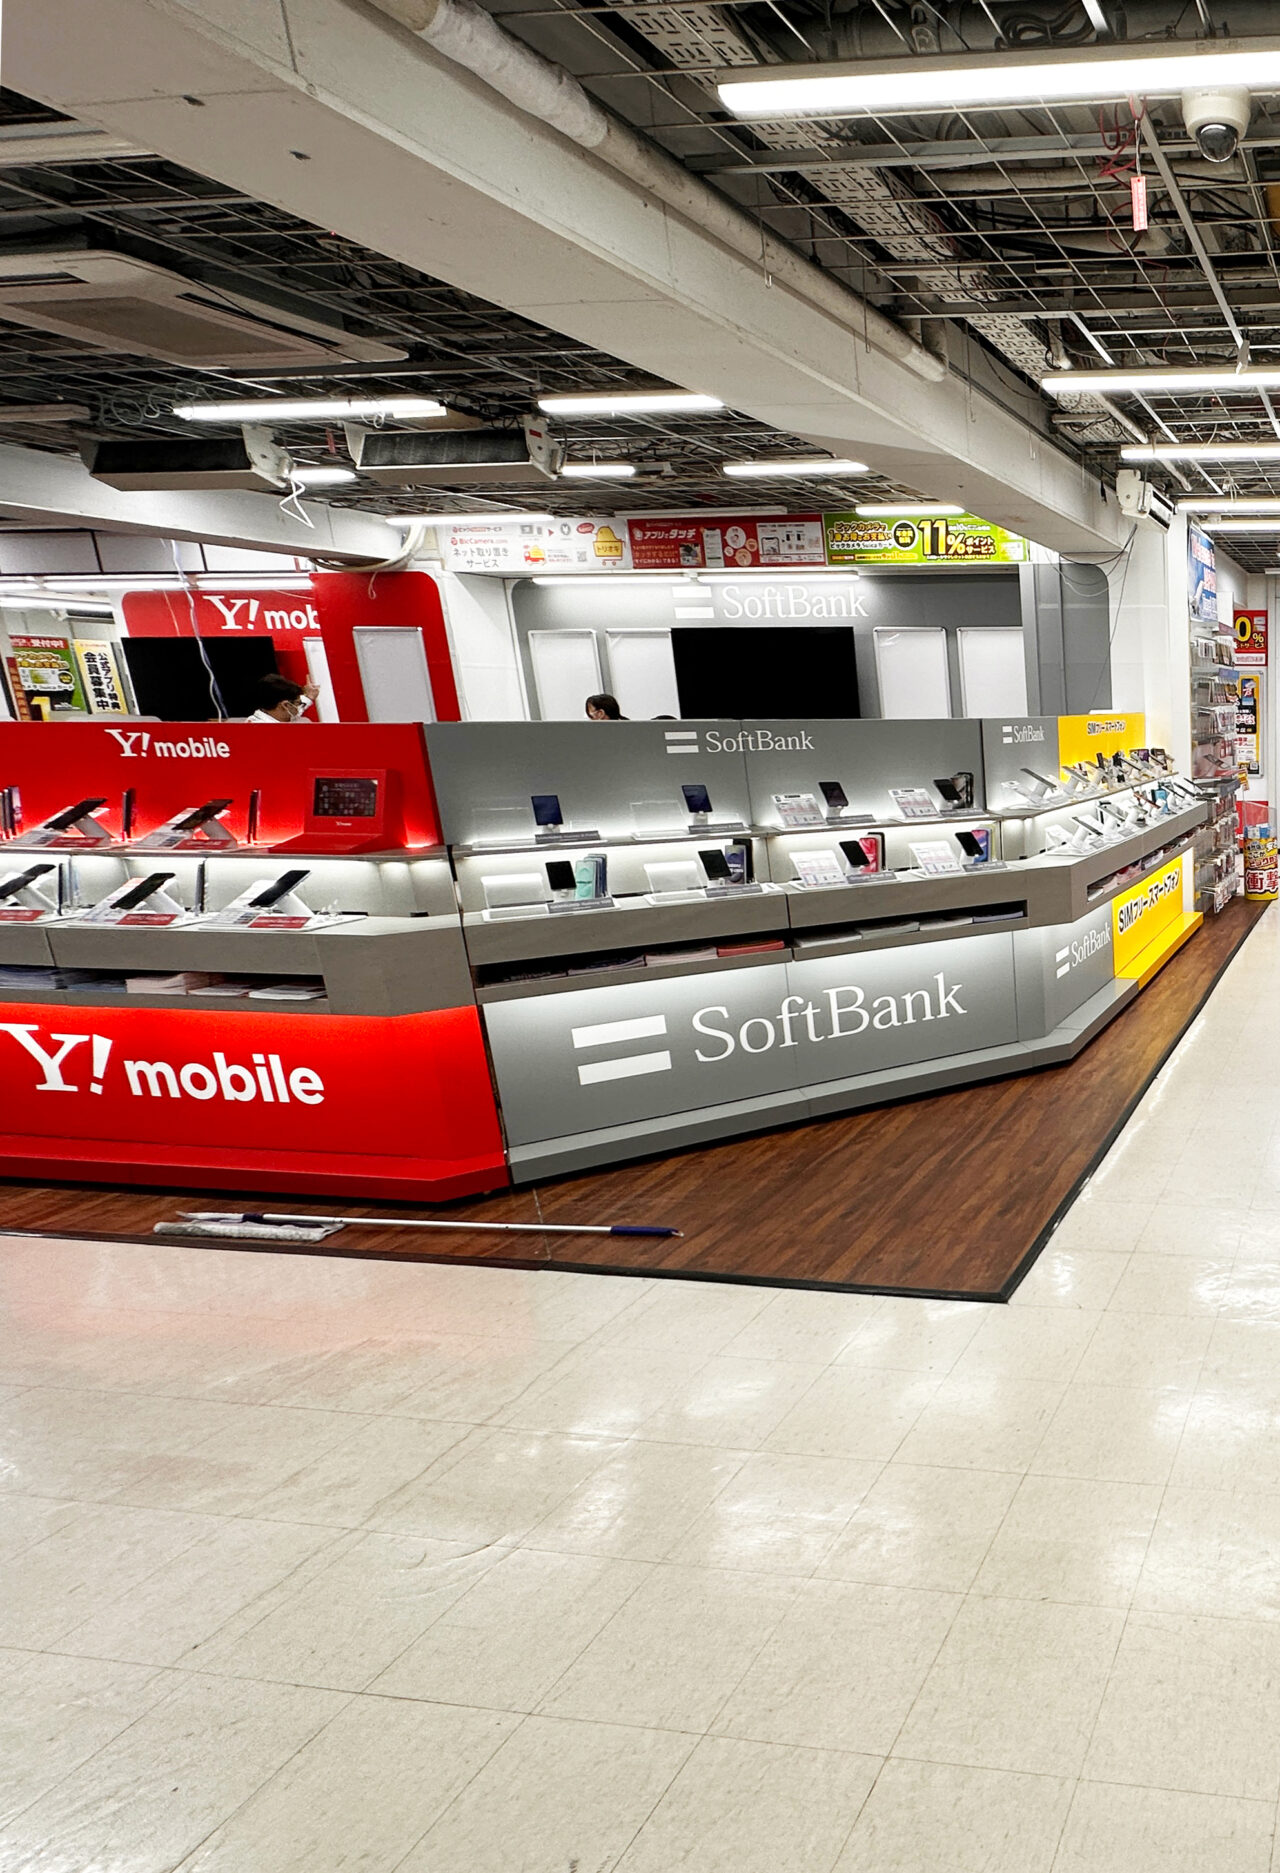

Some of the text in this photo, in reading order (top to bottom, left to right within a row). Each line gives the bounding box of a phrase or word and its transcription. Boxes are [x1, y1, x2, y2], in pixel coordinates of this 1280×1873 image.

[453, 547, 510, 558] ネット取り置き
[917, 519, 967, 555] 11%
[965, 536, 995, 546] ポイント
[965, 545, 997, 554] サービス
[466, 559, 500, 568] サービス
[202, 594, 260, 630] Y!
[723, 585, 869, 621] SoftBank
[105, 729, 231, 760] Y! mobile
[705, 730, 816, 754] SoftBank
[1013, 724, 1046, 743] SoftBank
[1117, 868, 1181, 935] SIMフリースマートフォン
[1070, 920, 1112, 968] SoftBank
[691, 971, 967, 1063] SoftBank
[0, 1022, 325, 1105] Y! mobile
